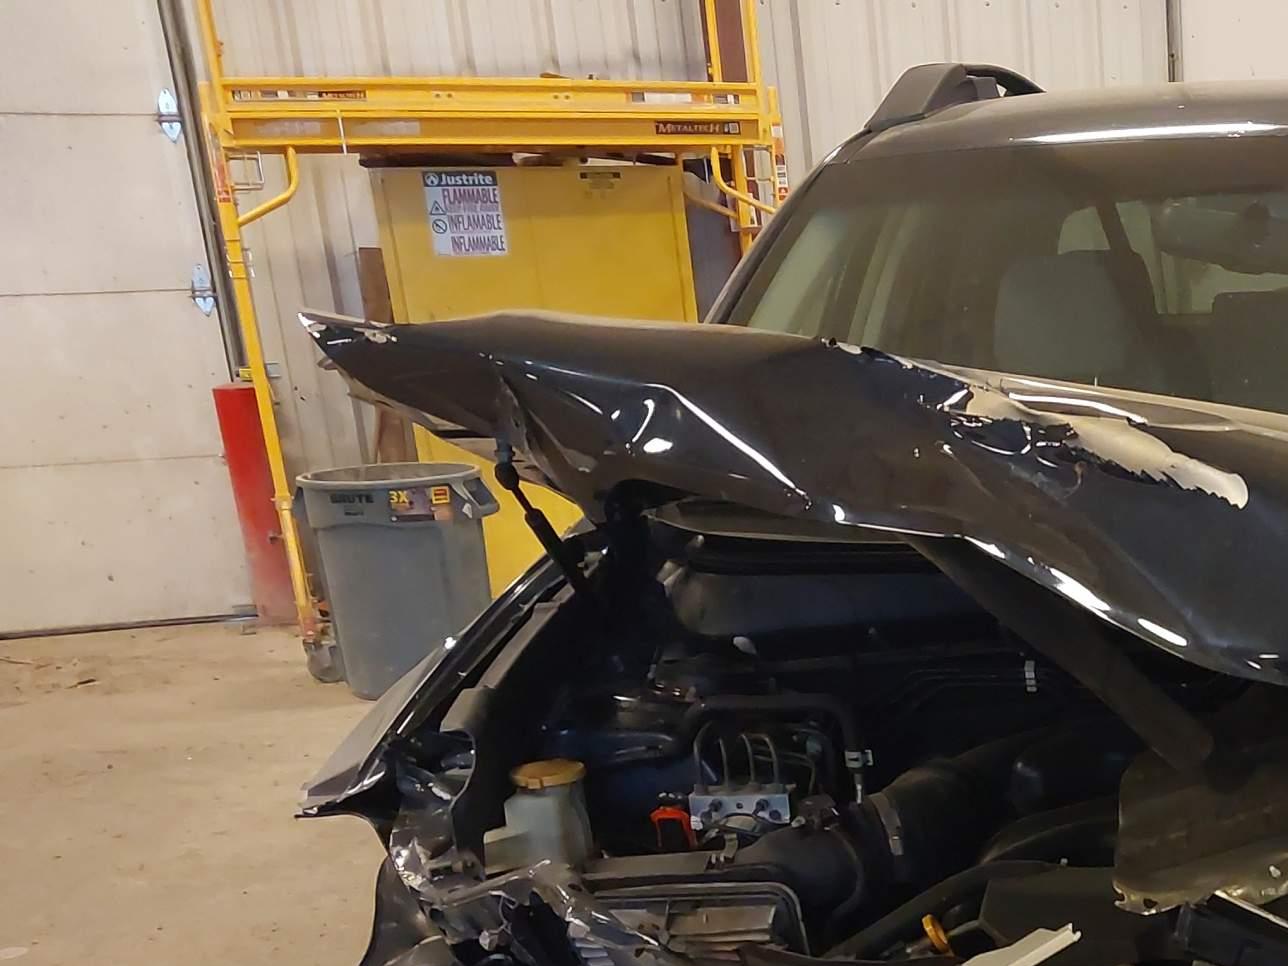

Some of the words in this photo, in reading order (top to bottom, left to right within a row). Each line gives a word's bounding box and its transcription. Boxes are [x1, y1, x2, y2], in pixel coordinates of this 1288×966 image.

[440, 173, 493, 185] Justrite
[442, 188, 499, 206] FLAMMABLE
[448, 214, 503, 232] INFLAMABLE
[451, 235, 506, 252] INFLAMMABLE
[388, 490, 409, 503] 3X
